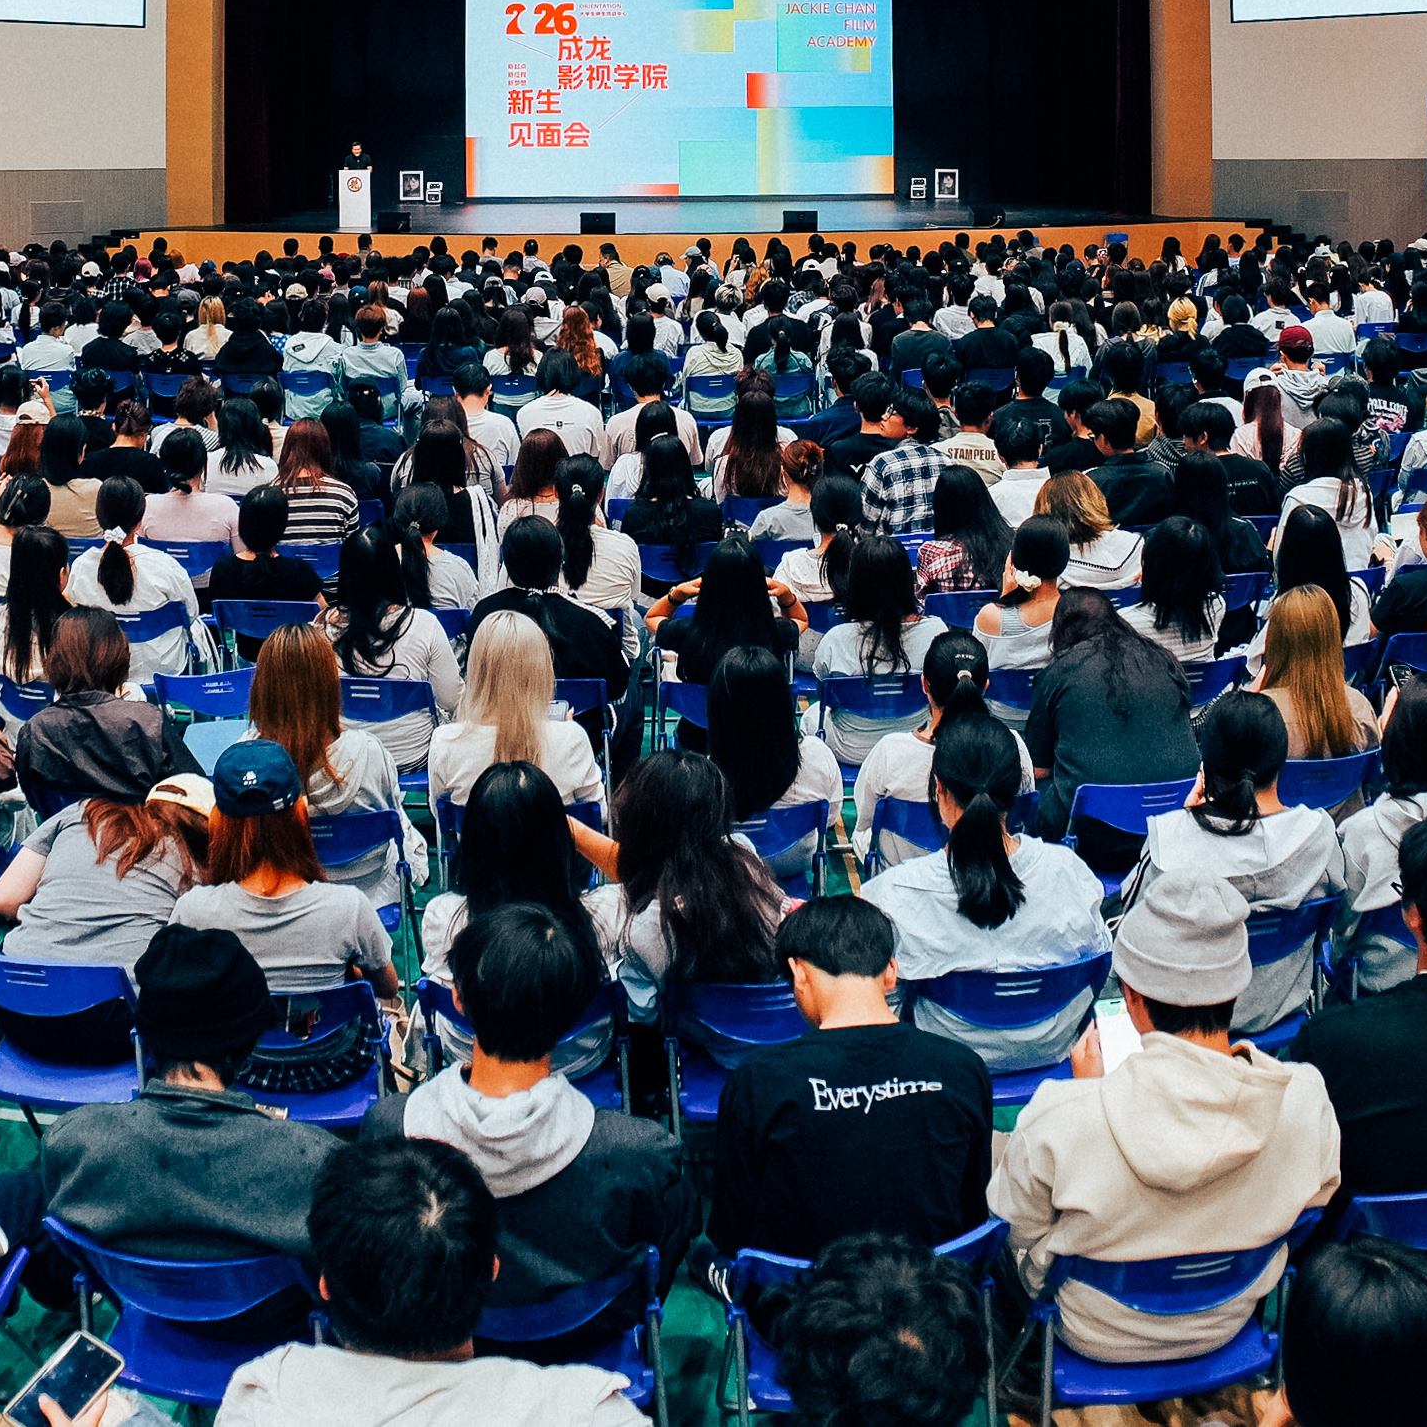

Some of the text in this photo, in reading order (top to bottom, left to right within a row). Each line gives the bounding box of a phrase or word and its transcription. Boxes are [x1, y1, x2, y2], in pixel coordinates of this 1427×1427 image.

[786, 3, 876, 14] JACKIE CHAN
[844, 19, 876, 31] FILM
[558, 35, 612, 61] 成龙
[807, 36, 877, 48] ACADEMY
[558, 64, 668, 90] 影视学院
[508, 89, 561, 114] 新生
[508, 122, 590, 147] 见面会
[948, 448, 996, 461] STAMPEDE
[808, 1077, 943, 1114] Everystime
